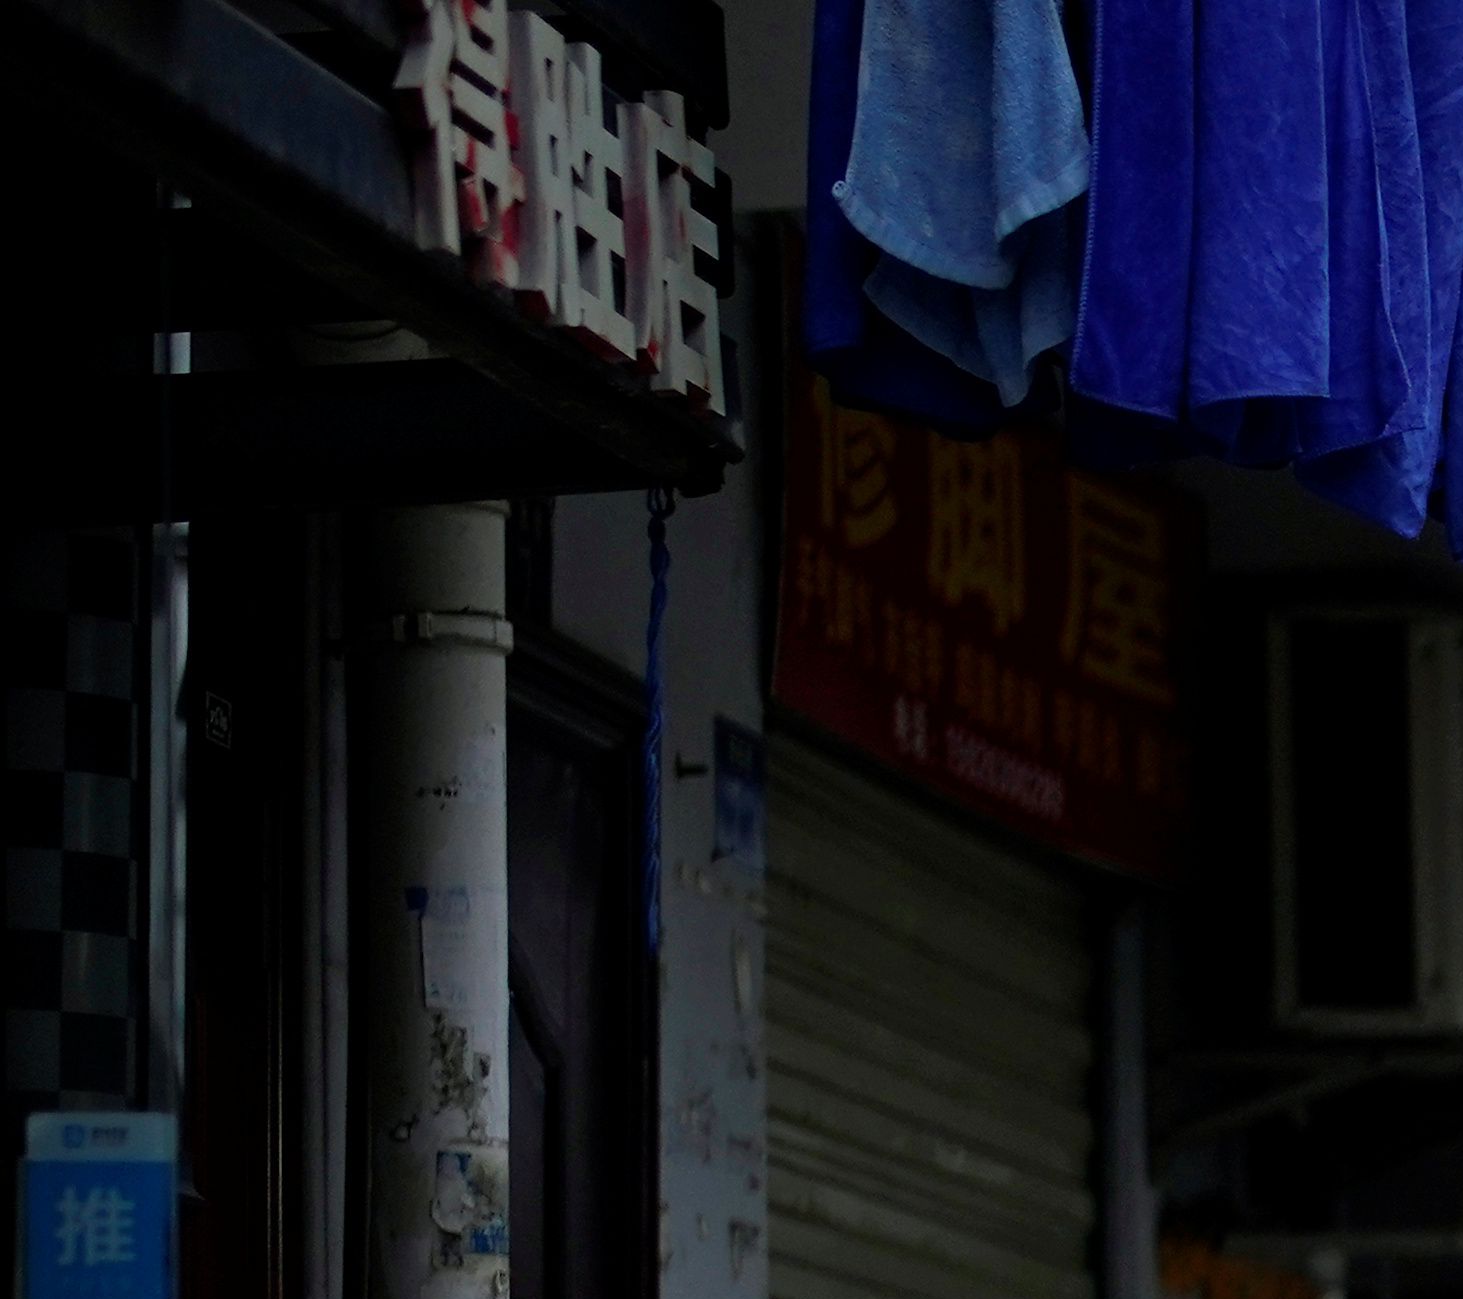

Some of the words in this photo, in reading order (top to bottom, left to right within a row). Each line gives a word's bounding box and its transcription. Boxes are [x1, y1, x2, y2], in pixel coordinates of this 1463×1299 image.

[812, 372, 1177, 707] 修脚屋
[54, 1184, 137, 1268] 推
